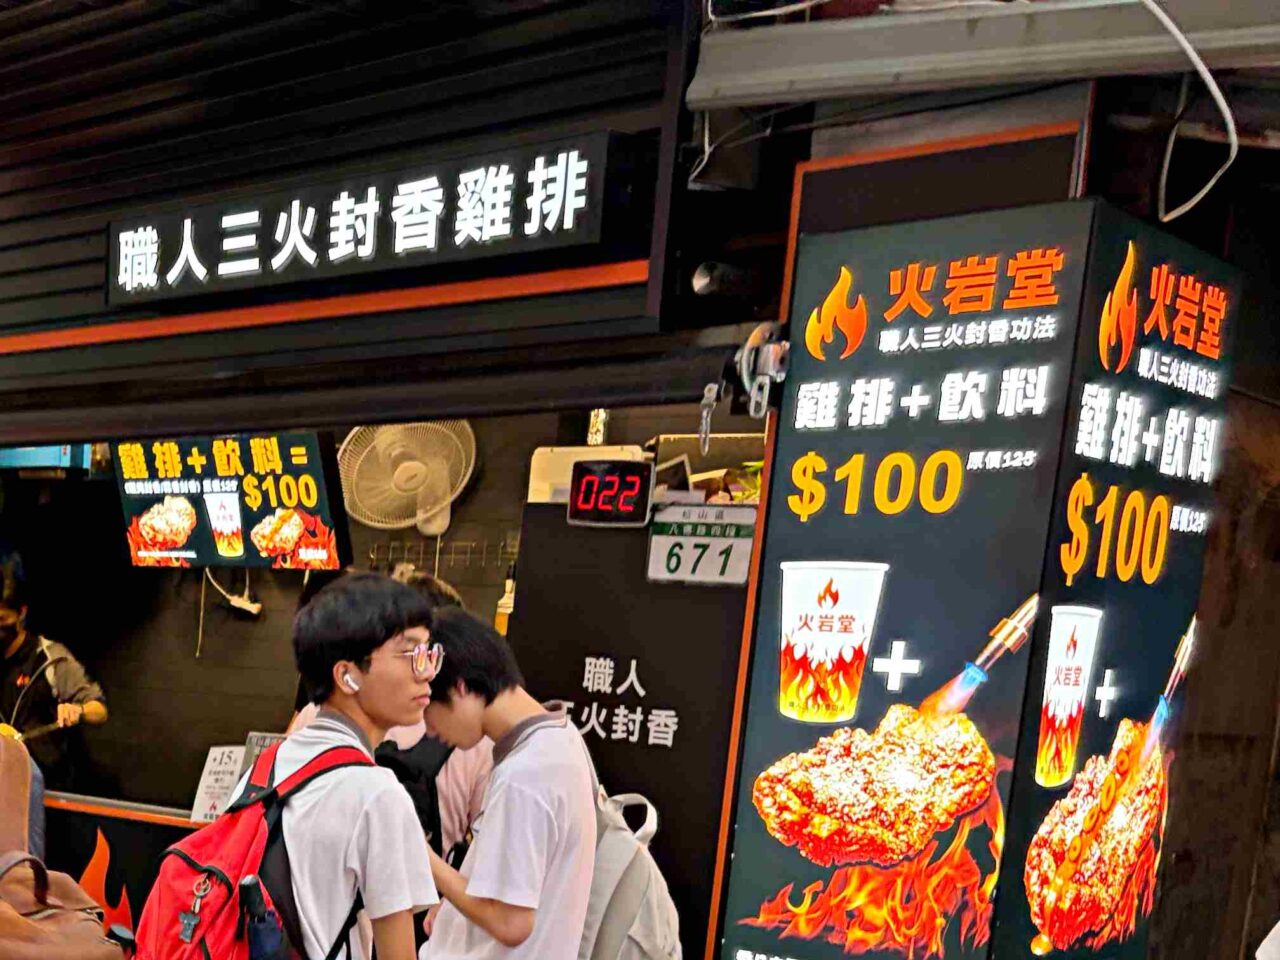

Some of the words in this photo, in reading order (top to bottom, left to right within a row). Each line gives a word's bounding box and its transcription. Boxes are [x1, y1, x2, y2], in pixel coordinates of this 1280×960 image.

[117, 149, 588, 293] 職人三火封香雞排
[883, 248, 1065, 323] 火岩堂
[1143, 264, 1227, 360] 火岩堂
[878, 315, 1058, 353] 職人三火封香功法
[794, 365, 1050, 429] 雞排+飲料
[1075, 383, 1219, 483] 雞排+飲料
[242, 474, 318, 511] $100
[576, 474, 641, 512] 022
[787, 449, 963, 523] $100
[1060, 472, 1169, 587] $100
[666, 541, 734, 577] 671
[798, 612, 856, 634] 火岩堂
[582, 656, 647, 698] 職人
[1053, 666, 1083, 687] 火岩堂
